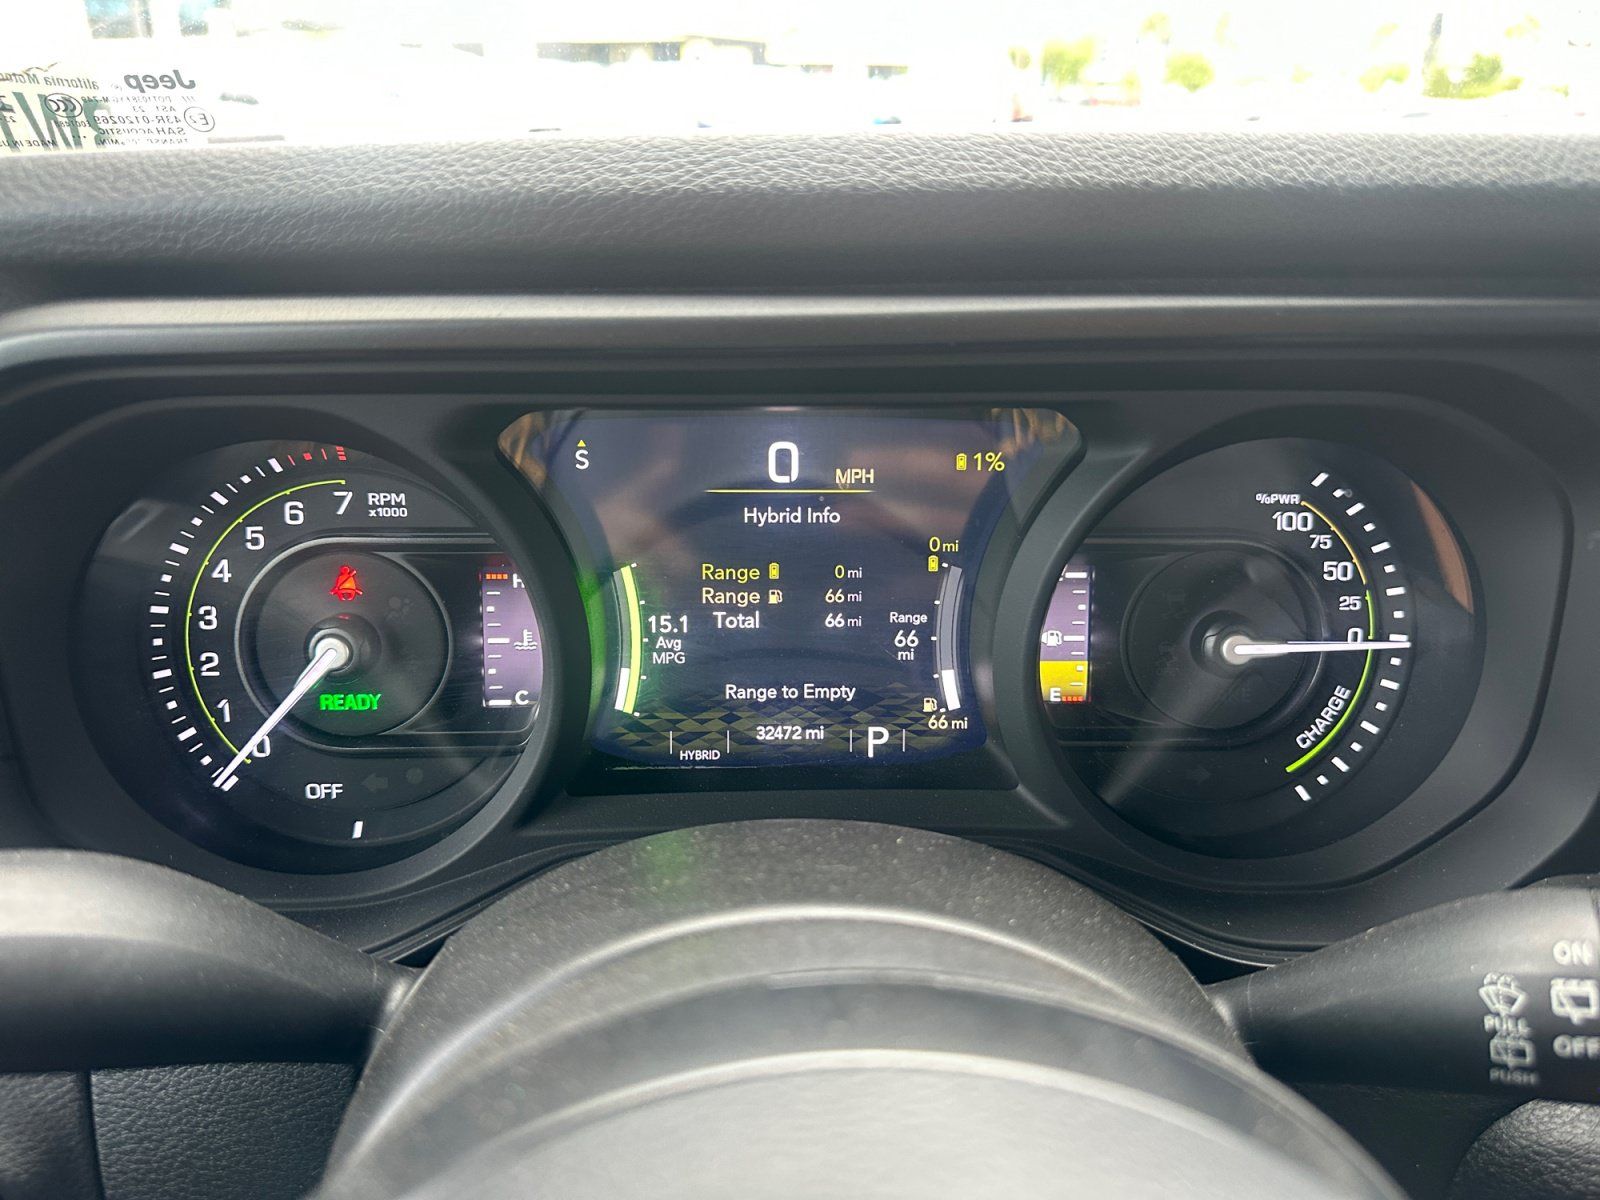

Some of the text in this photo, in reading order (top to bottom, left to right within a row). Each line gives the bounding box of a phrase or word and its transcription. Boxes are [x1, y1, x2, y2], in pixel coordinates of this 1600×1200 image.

[575, 449, 590, 470] S
[768, 441, 875, 485] 0 MPH
[973, 452, 1005, 472] 1%
[333, 491, 353, 515] 7
[367, 492, 406, 506] RPM
[284, 501, 304, 526] 6
[368, 506, 408, 518] x1000
[743, 506, 841, 528] Hybrid Info
[1272, 511, 1314, 532] 100
[245, 526, 265, 551] 5
[929, 536, 960, 553] 0 mi
[1309, 534, 1333, 551] 75
[212, 560, 232, 583] 4
[701, 563, 760, 582] Range
[834, 564, 863, 579] 0 mi
[1323, 561, 1354, 582] 50
[701, 587, 760, 607] Range
[825, 588, 863, 603] 66 mi
[1338, 595, 1362, 611] 25
[198, 605, 219, 631] 3
[648, 614, 688, 633] 15.1
[712, 610, 760, 629] Total
[824, 612, 862, 628] 66 mi
[889, 611, 928, 625] Range
[656, 636, 682, 651] Avg
[894, 629, 919, 648] 66
[1347, 627, 1363, 644] 0
[652, 651, 686, 665] MPG
[897, 648, 915, 661] mi
[200, 652, 220, 677] 2
[319, 693, 381, 711] READY
[514, 690, 529, 705] C
[725, 683, 856, 703] Range to Empty
[1050, 687, 1062, 703] E
[216, 699, 232, 723] 1
[1296, 685, 1351, 750] CHARGE
[928, 715, 968, 730] 66 mi
[756, 725, 825, 741] 32472 mi
[867, 726, 890, 758] P
[252, 734, 271, 758] 0
[679, 750, 721, 762] HYBRID
[305, 783, 344, 800] OFF
[1552, 939, 1595, 966] ON
[1483, 1013, 1533, 1038] PULL
[1552, 1034, 1600, 1060] OFF
[1489, 1067, 1541, 1086] PUSH
